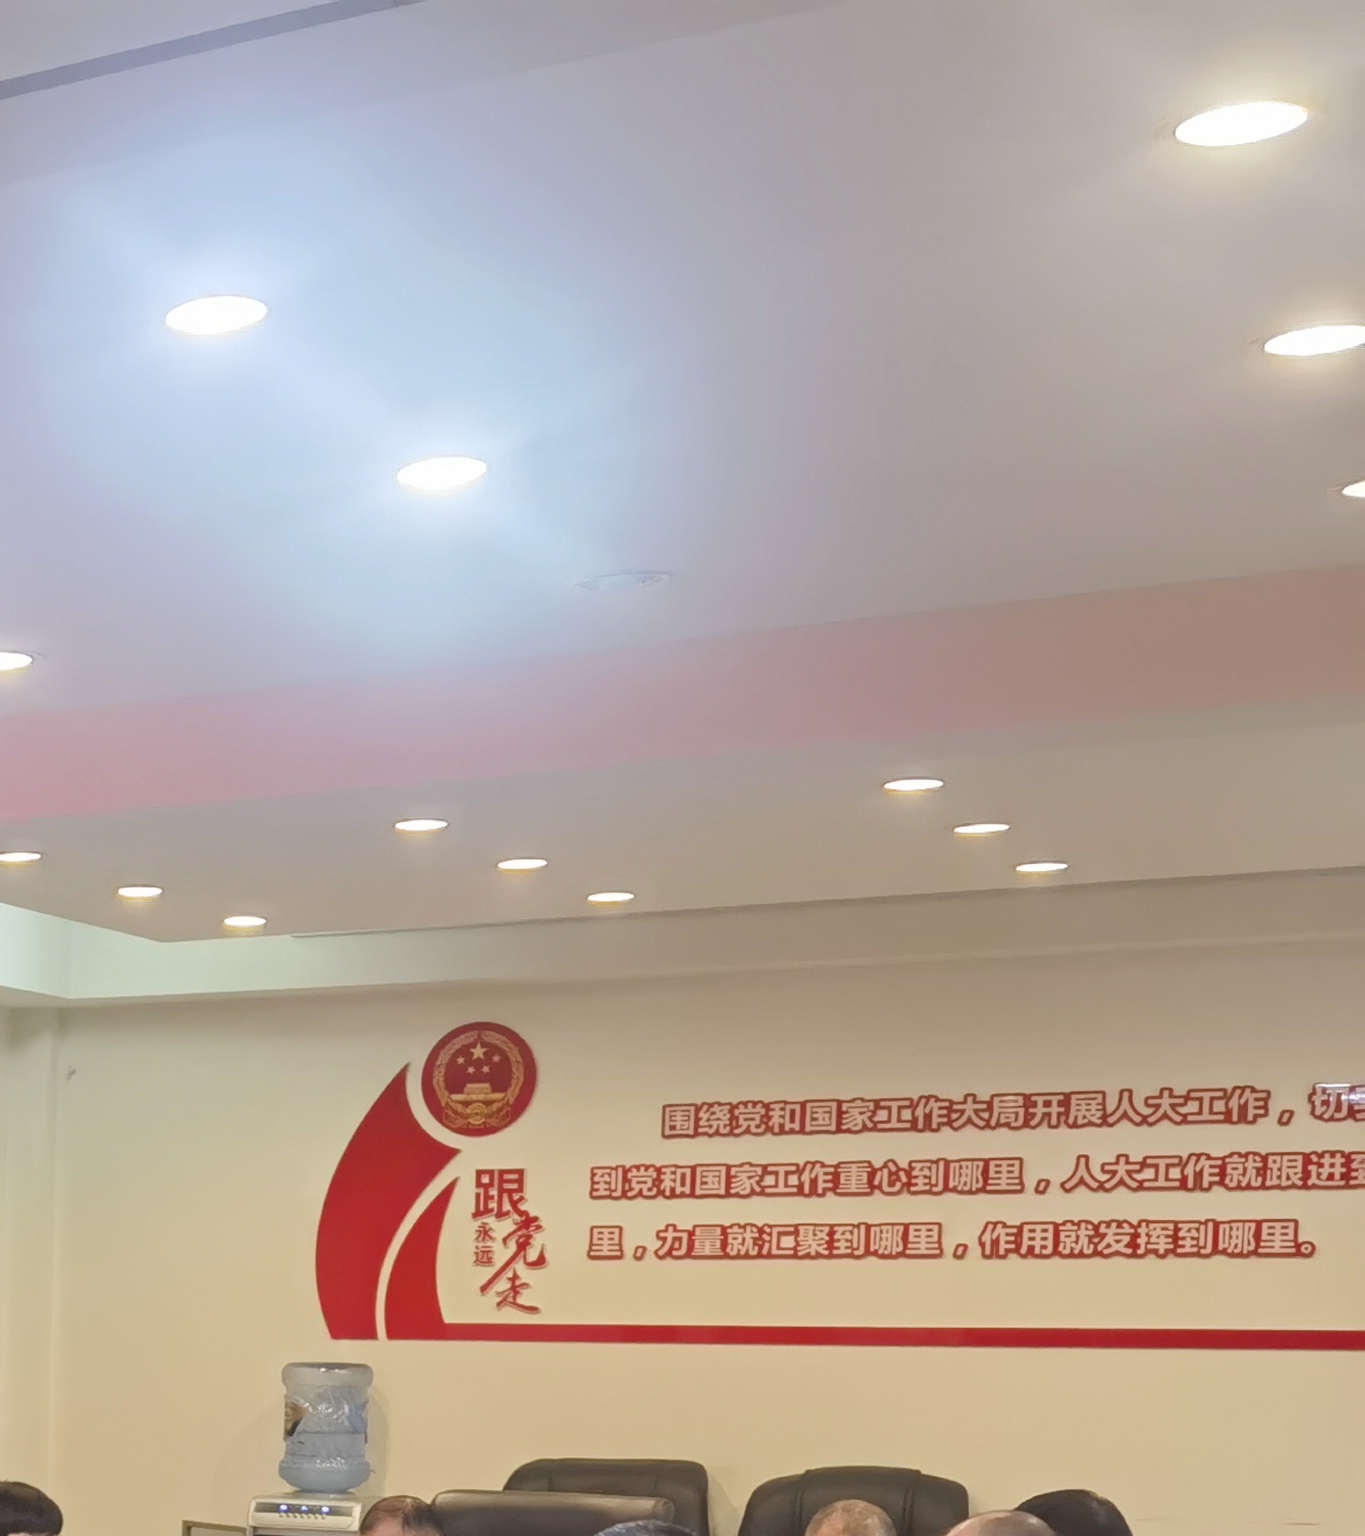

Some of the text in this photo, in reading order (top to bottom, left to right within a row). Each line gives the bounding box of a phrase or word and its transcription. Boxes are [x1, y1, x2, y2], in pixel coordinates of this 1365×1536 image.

[474, 1222, 495, 1267] 永远
[587, 1219, 1317, 1260] 里，力量就汇聚到哪里，作用就发挥到哪里。
